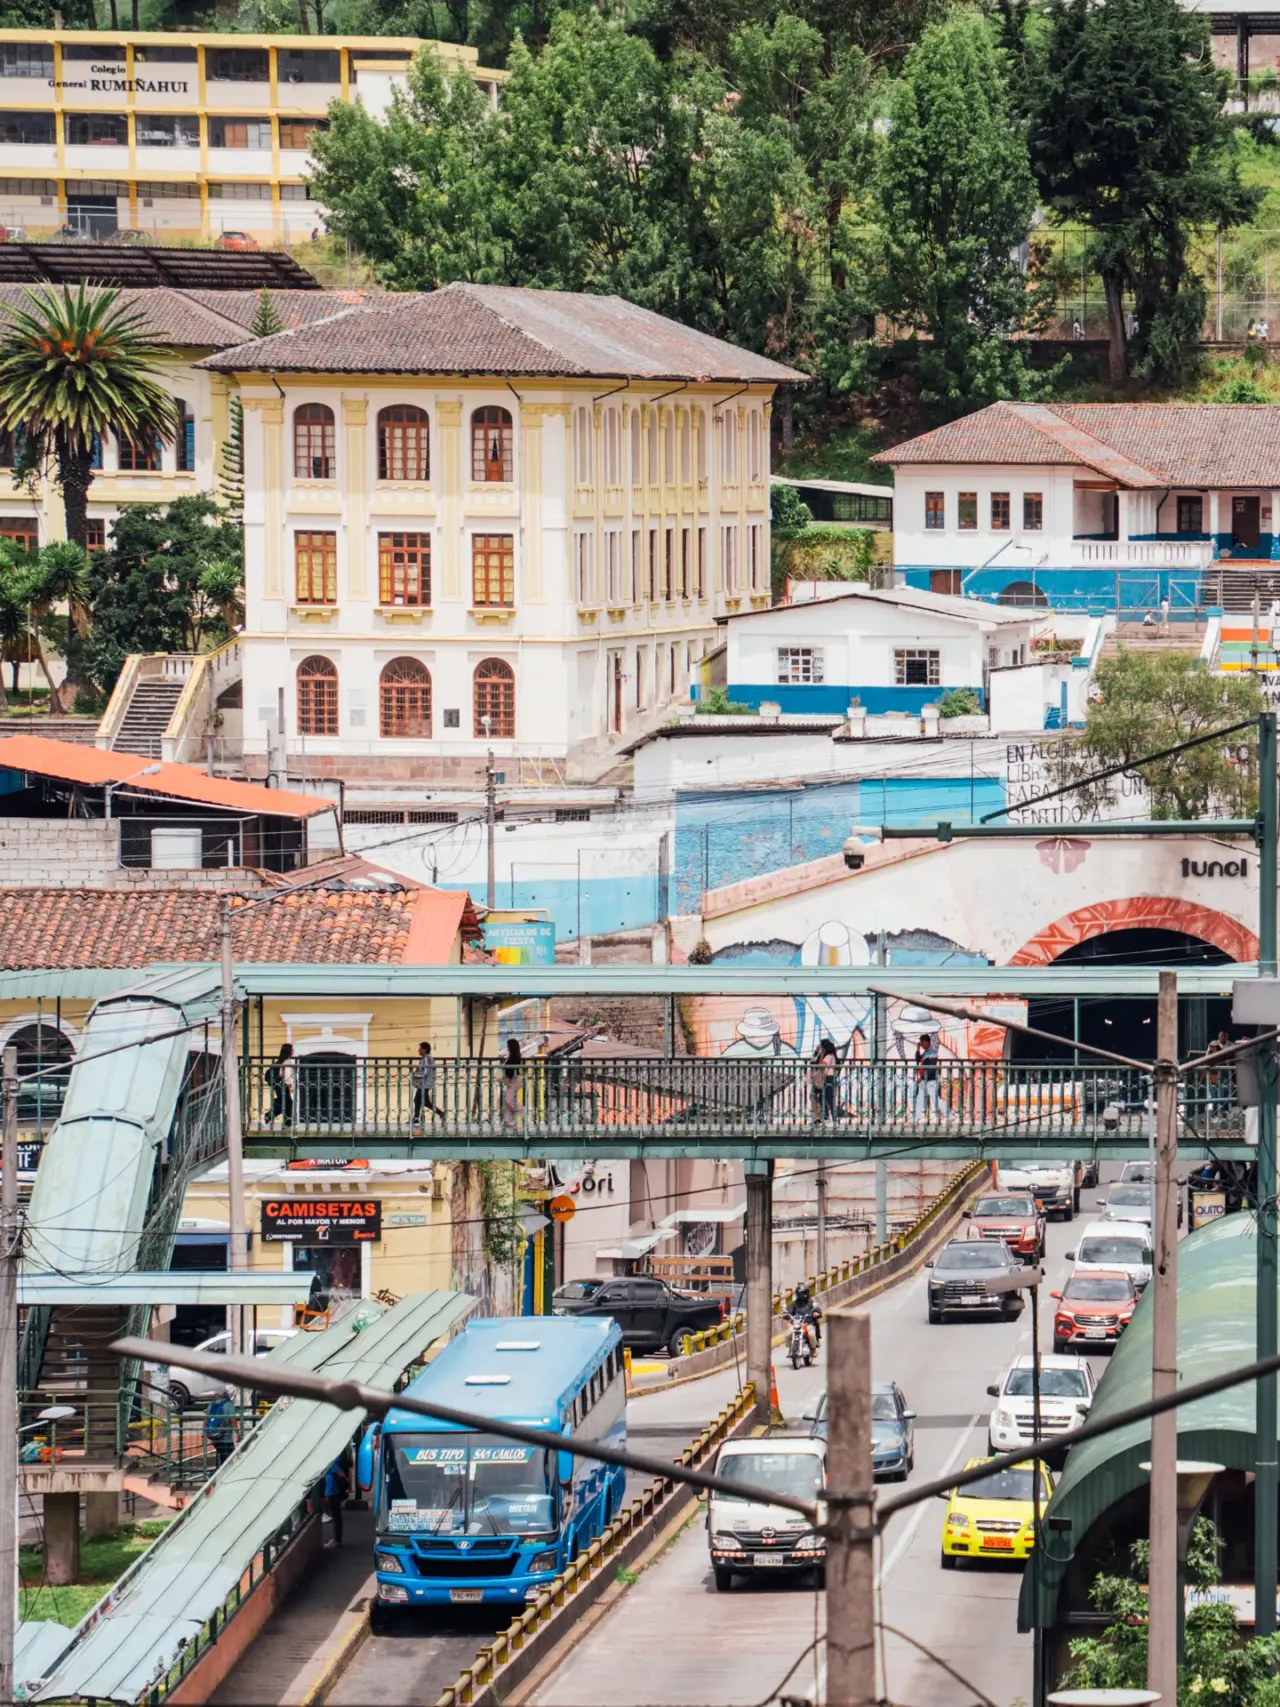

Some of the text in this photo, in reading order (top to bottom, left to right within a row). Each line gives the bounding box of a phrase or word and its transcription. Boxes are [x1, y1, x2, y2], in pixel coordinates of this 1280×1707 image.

[91, 64, 126, 75] Colegio
[48, 78, 188, 93] General RUMIÑAHUI
[1007, 745, 1024, 763] EN
[1181, 858, 1248, 877] tunel
[540, 928, 552, 937] DE
[504, 937, 536, 945] FIESTA
[266, 1203, 377, 1217] CAMISETAS
[1196, 1204, 1226, 1215] QUITO
[415, 1448, 439, 1460] BUS
[440, 1448, 465, 1460] TIPO
[492, 1448, 527, 1460] CARLOS
